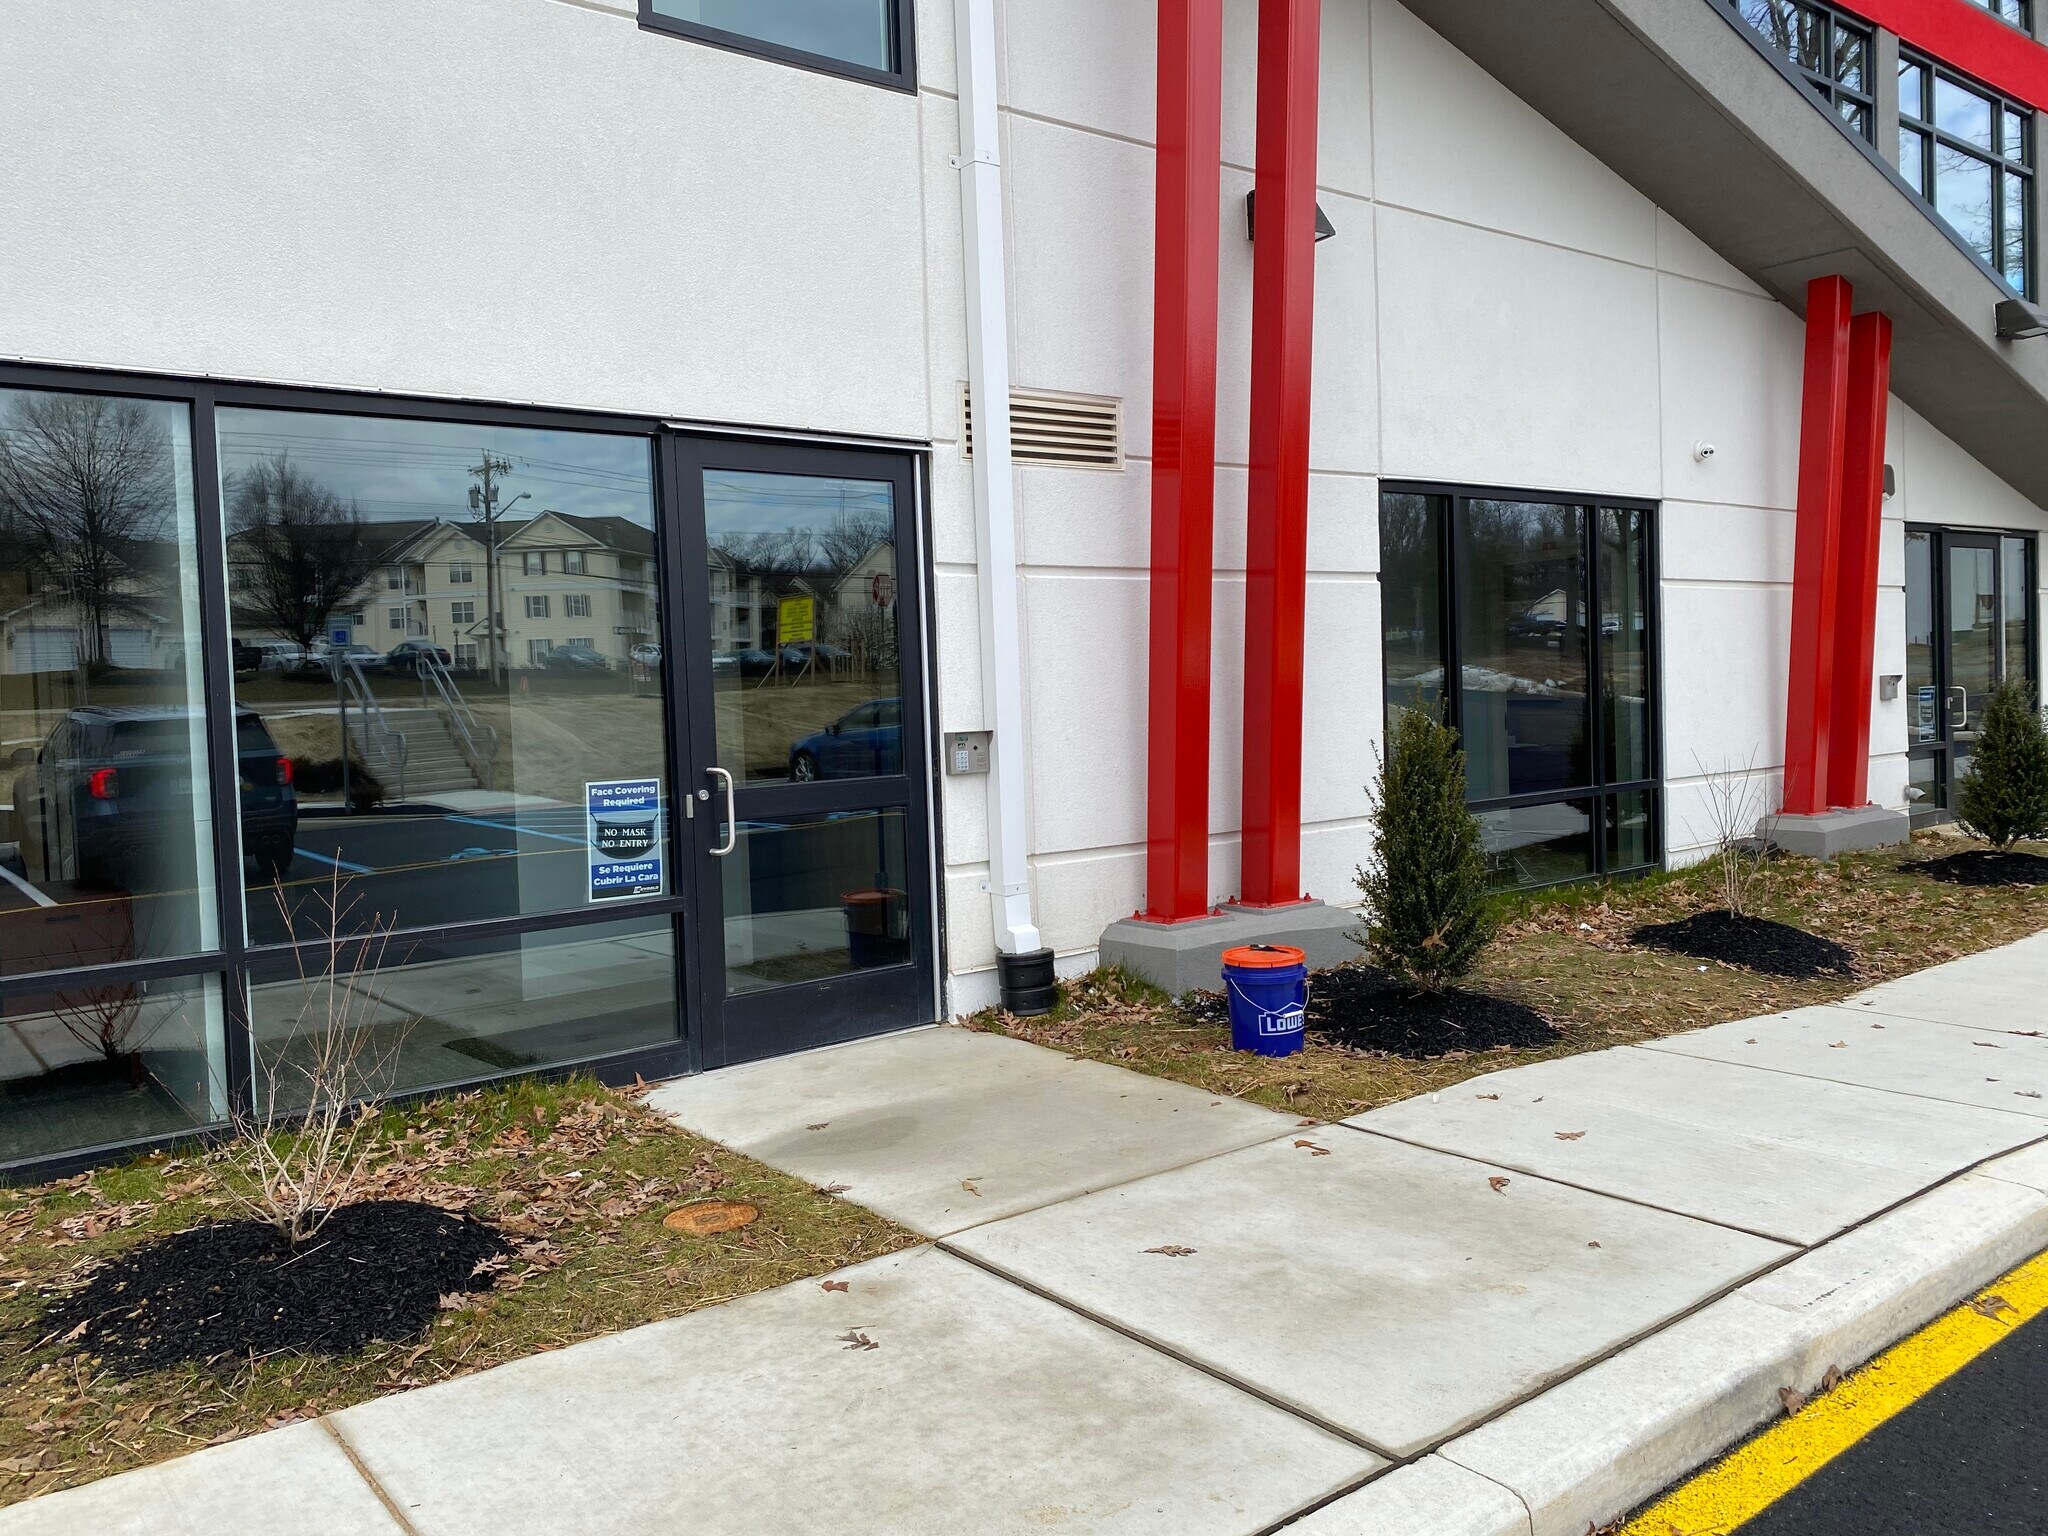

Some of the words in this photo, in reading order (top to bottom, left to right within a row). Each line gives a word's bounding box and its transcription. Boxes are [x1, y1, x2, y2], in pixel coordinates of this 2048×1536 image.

[591, 788, 613, 796] Face
[614, 785, 656, 795] Covering
[603, 796, 645, 807] Required
[604, 829, 618, 837] NO
[622, 828, 647, 837] MASK
[601, 840, 615, 848] NO
[619, 839, 649, 848] ENTRY
[598, 866, 611, 874] Se
[612, 863, 653, 873] Requiere
[593, 876, 623, 886] Cubrir
[625, 874, 637, 883] La
[637, 873, 659, 881] Cara
